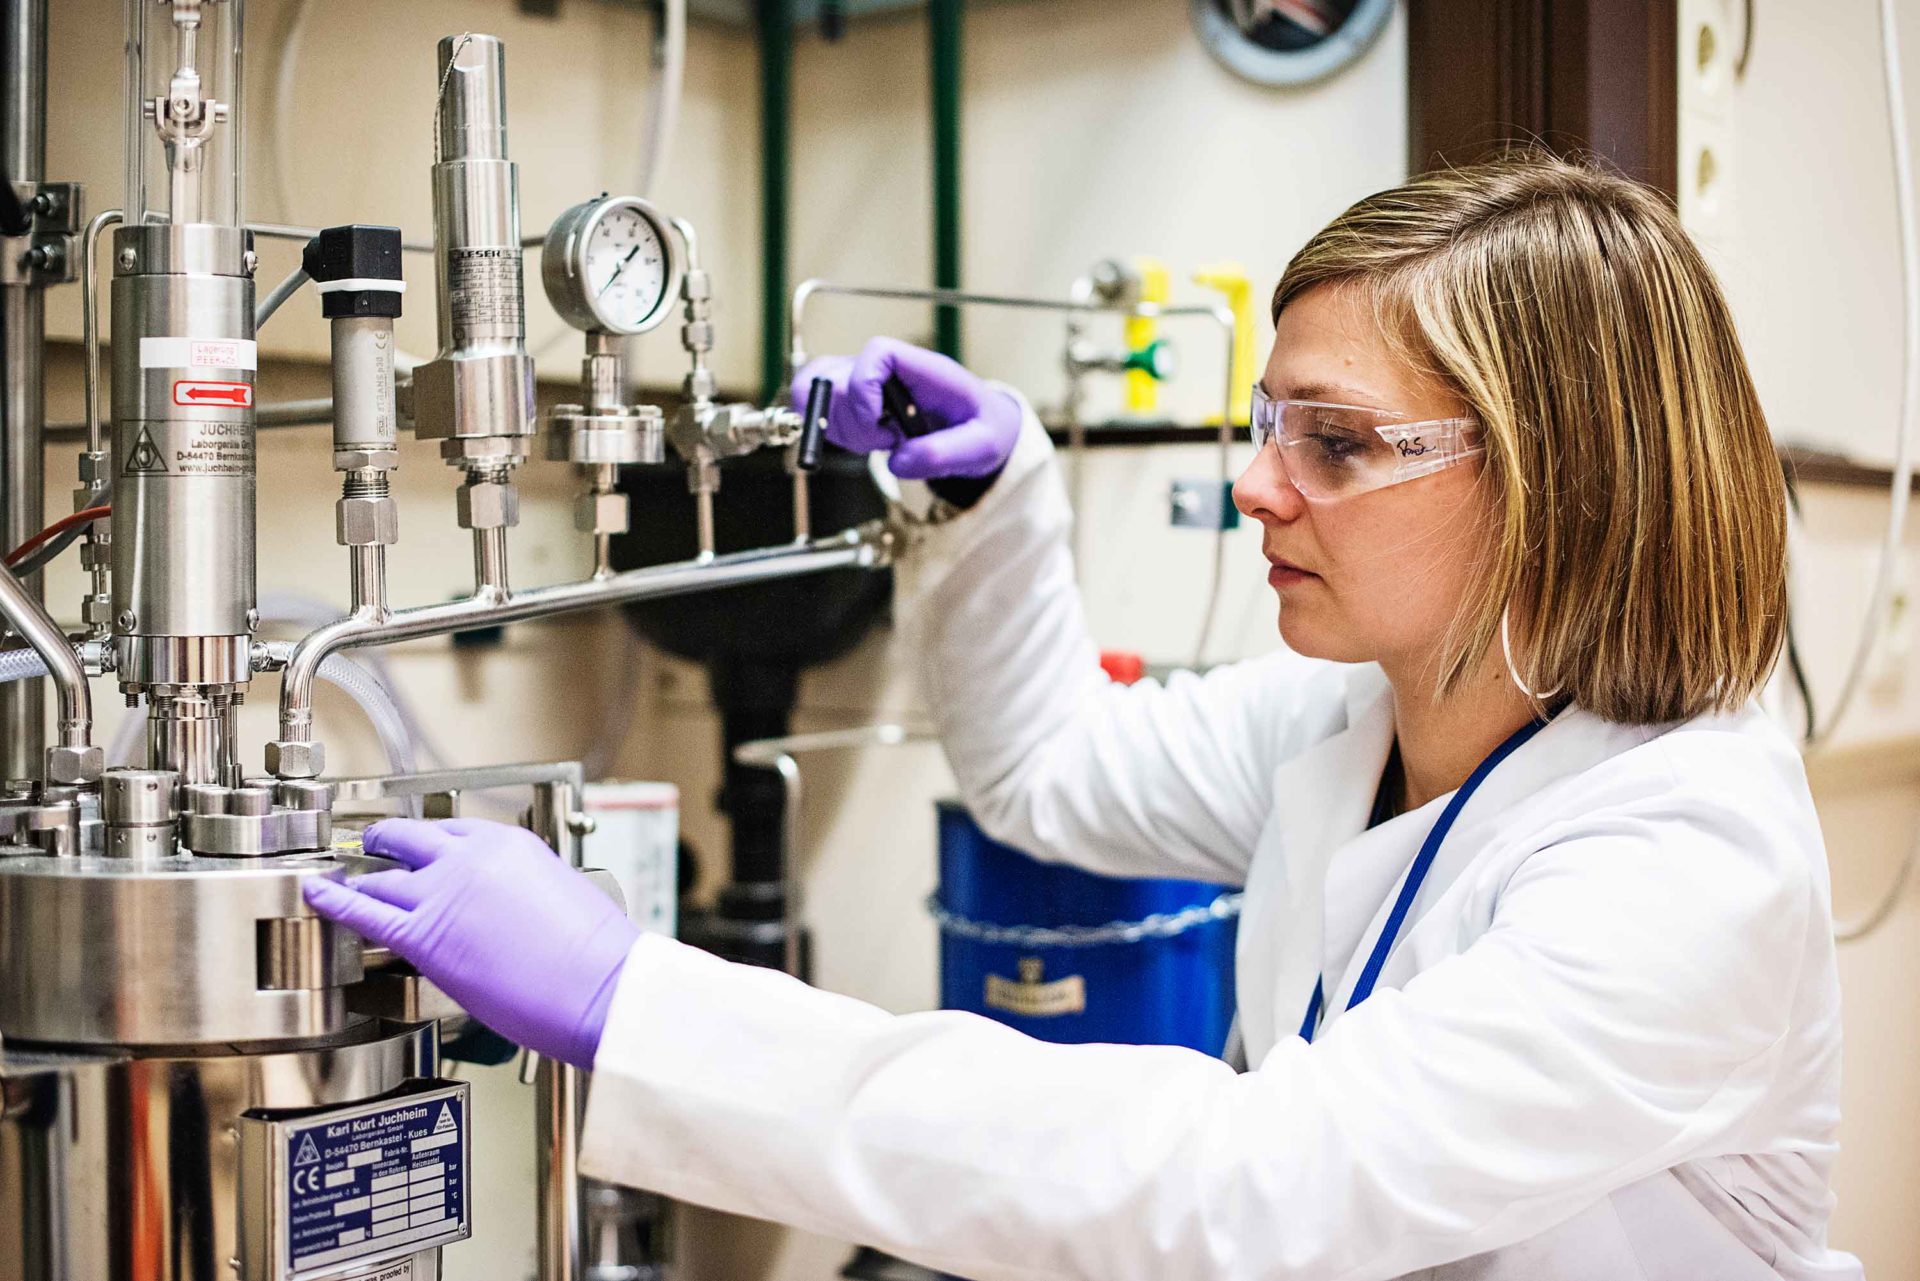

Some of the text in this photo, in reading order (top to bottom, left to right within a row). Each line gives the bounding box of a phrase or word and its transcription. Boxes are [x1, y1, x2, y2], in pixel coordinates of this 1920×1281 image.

[461, 250, 500, 258] LESER
[177, 451, 214, 461] D-54470
[327, 1122, 350, 1138] Karl
[352, 1117, 376, 1132] Kurt
[378, 1107, 428, 1127] Juchheim
[387, 1123, 404, 1133] GmbH
[325, 1143, 359, 1159] D-54470
[360, 1132, 403, 1150] Bernkastel
[408, 1128, 428, 1139] Kues
[448, 1163, 457, 1171] bar
[448, 1178, 457, 1186] bar
[403, 1264, 410, 1274] by
